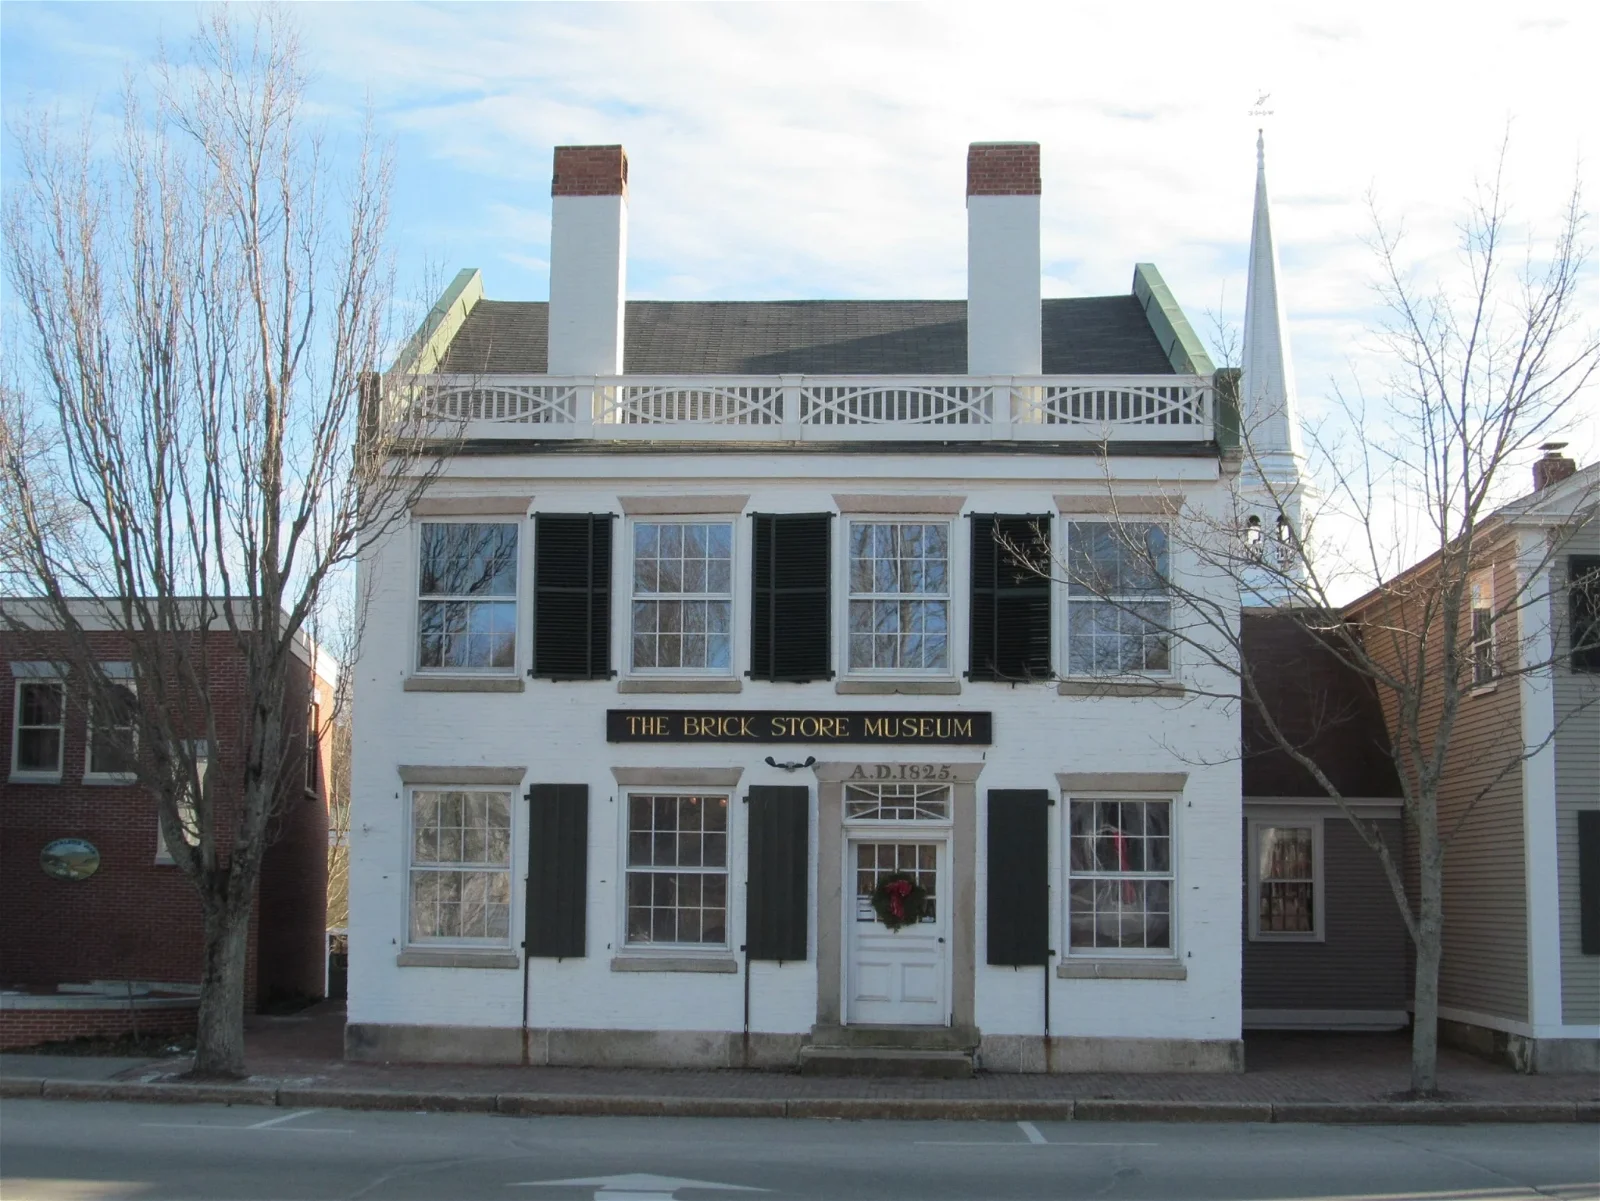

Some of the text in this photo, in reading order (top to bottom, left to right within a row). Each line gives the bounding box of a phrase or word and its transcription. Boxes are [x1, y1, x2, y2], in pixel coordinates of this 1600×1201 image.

[626, 716, 973, 738] THE BRICK STORE MUSEUM
